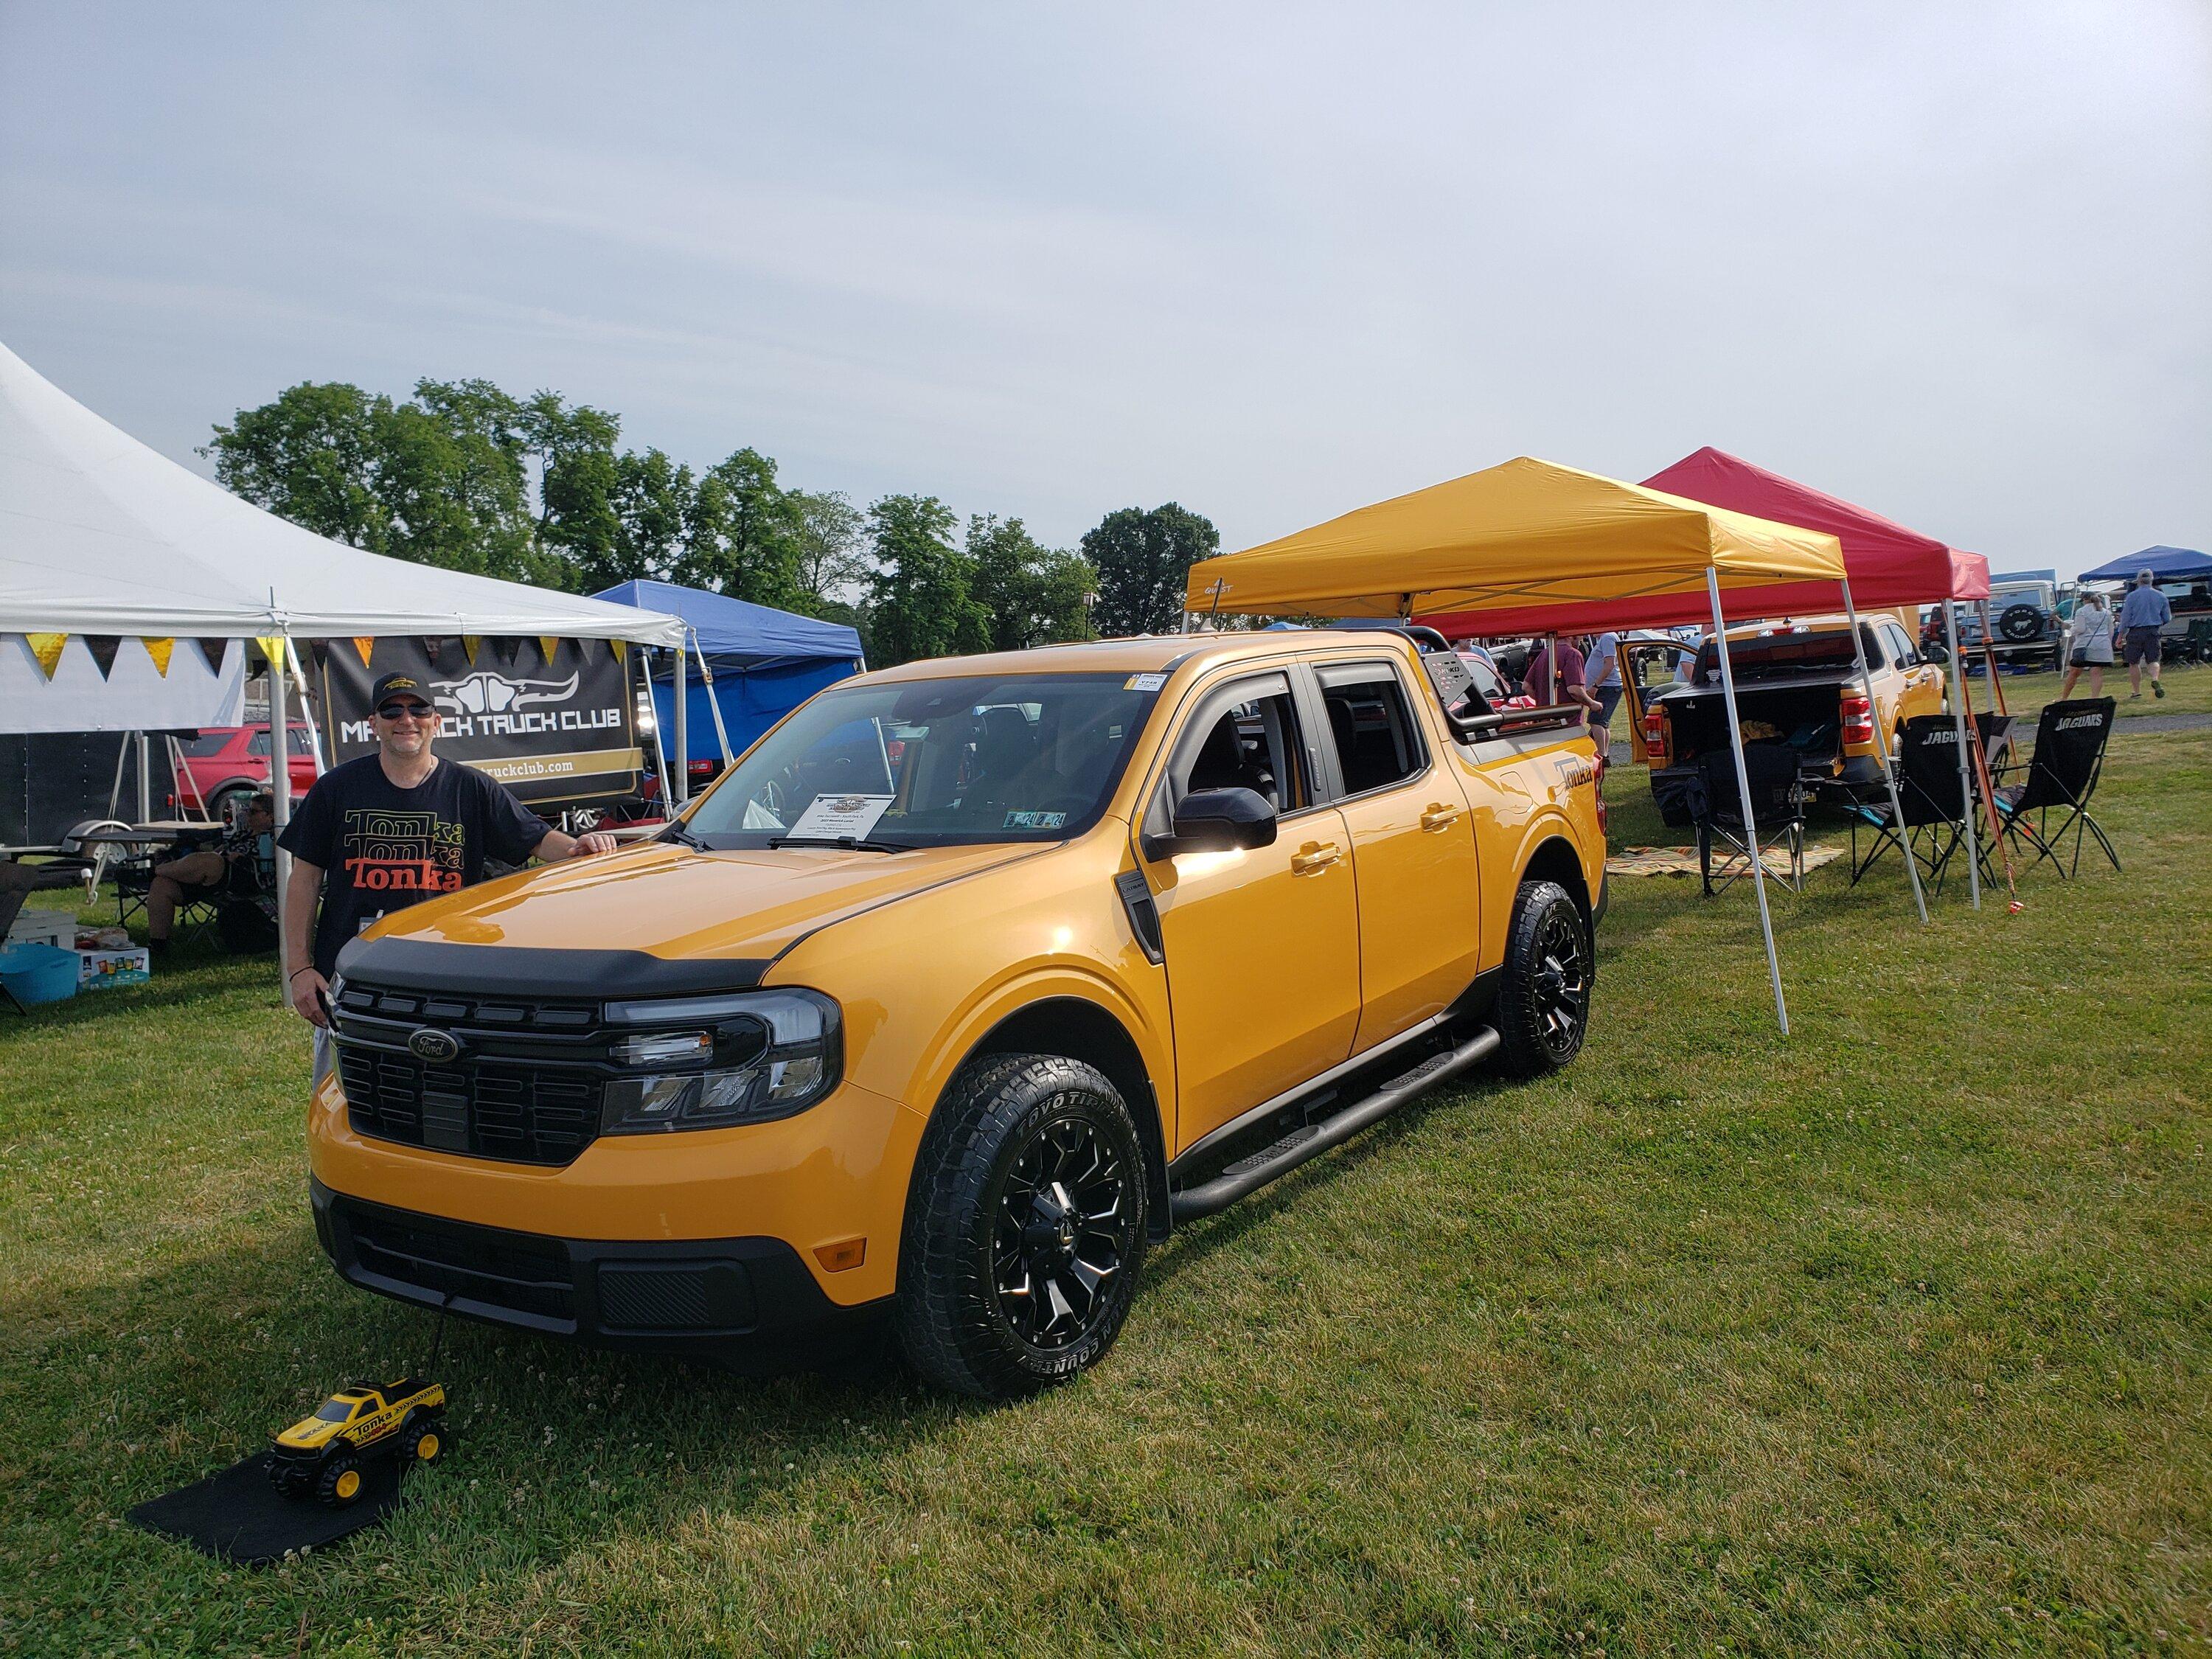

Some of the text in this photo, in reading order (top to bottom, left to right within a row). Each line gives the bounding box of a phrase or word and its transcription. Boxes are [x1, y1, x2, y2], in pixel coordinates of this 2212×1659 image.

[2008, 609, 2034, 617] FORD
[2006, 629, 2035, 639] BRONCO
[476, 712, 557, 736] TRUCK
[560, 709, 621, 731] CLUB
[2055, 713, 2103, 731] JAGUARS
[1921, 729, 1977, 745] JAGURS
[1553, 756, 1593, 790] Tonka
[344, 809, 465, 846] Tonka
[1026, 813, 1034, 825] 24
[1054, 814, 1064, 826] 24
[344, 834, 465, 870] Tonka
[345, 858, 463, 893] Tonka
[418, 1036, 448, 1057] Ford
[353, 1411, 393, 1436] Tonka
